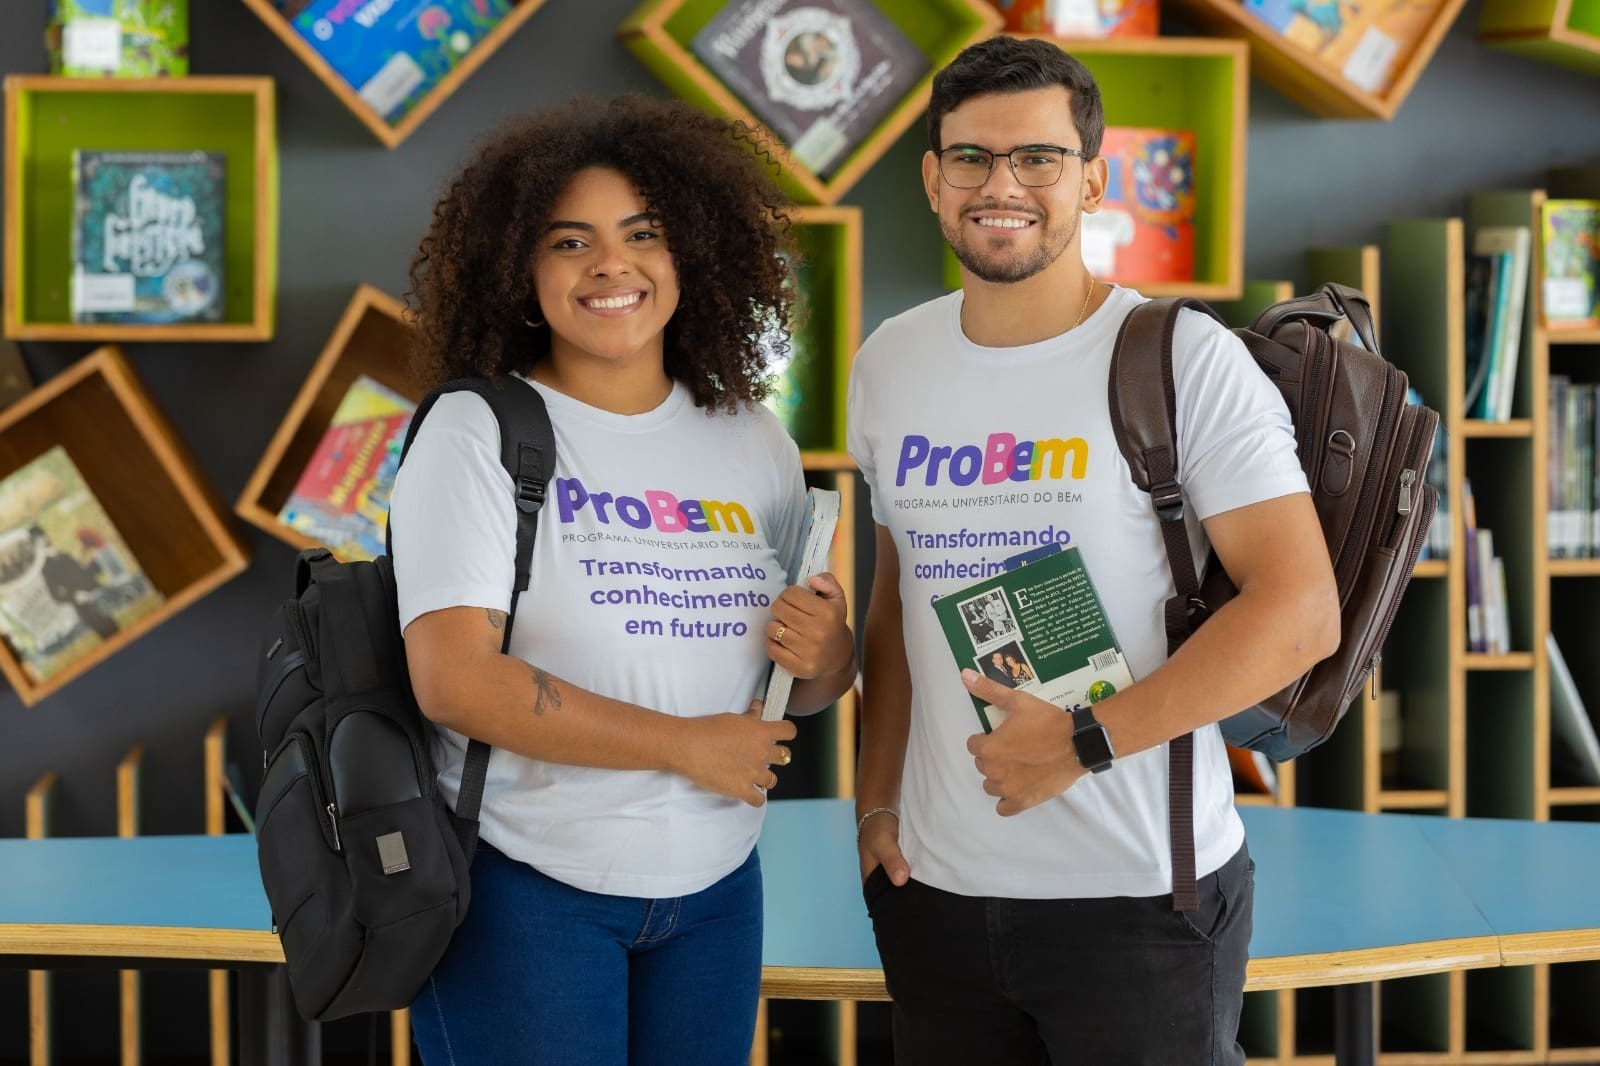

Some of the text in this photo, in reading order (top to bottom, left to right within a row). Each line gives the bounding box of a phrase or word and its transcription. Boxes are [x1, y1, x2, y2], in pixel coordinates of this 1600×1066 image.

[895, 432, 1089, 487] ProBem
[556, 477, 755, 535] ProBem
[894, 497, 949, 509] PROGRAMA
[1034, 492, 1053, 503] DO
[1057, 492, 1082, 503] BEM
[562, 532, 630, 543] PROGRAMA
[722, 540, 739, 549] DO
[742, 541, 762, 550] BEM
[906, 524, 1071, 549] Transformando
[579, 559, 766, 582] Transformando
[590, 585, 770, 609] conhecimento
[625, 618, 748, 638] em futuro
